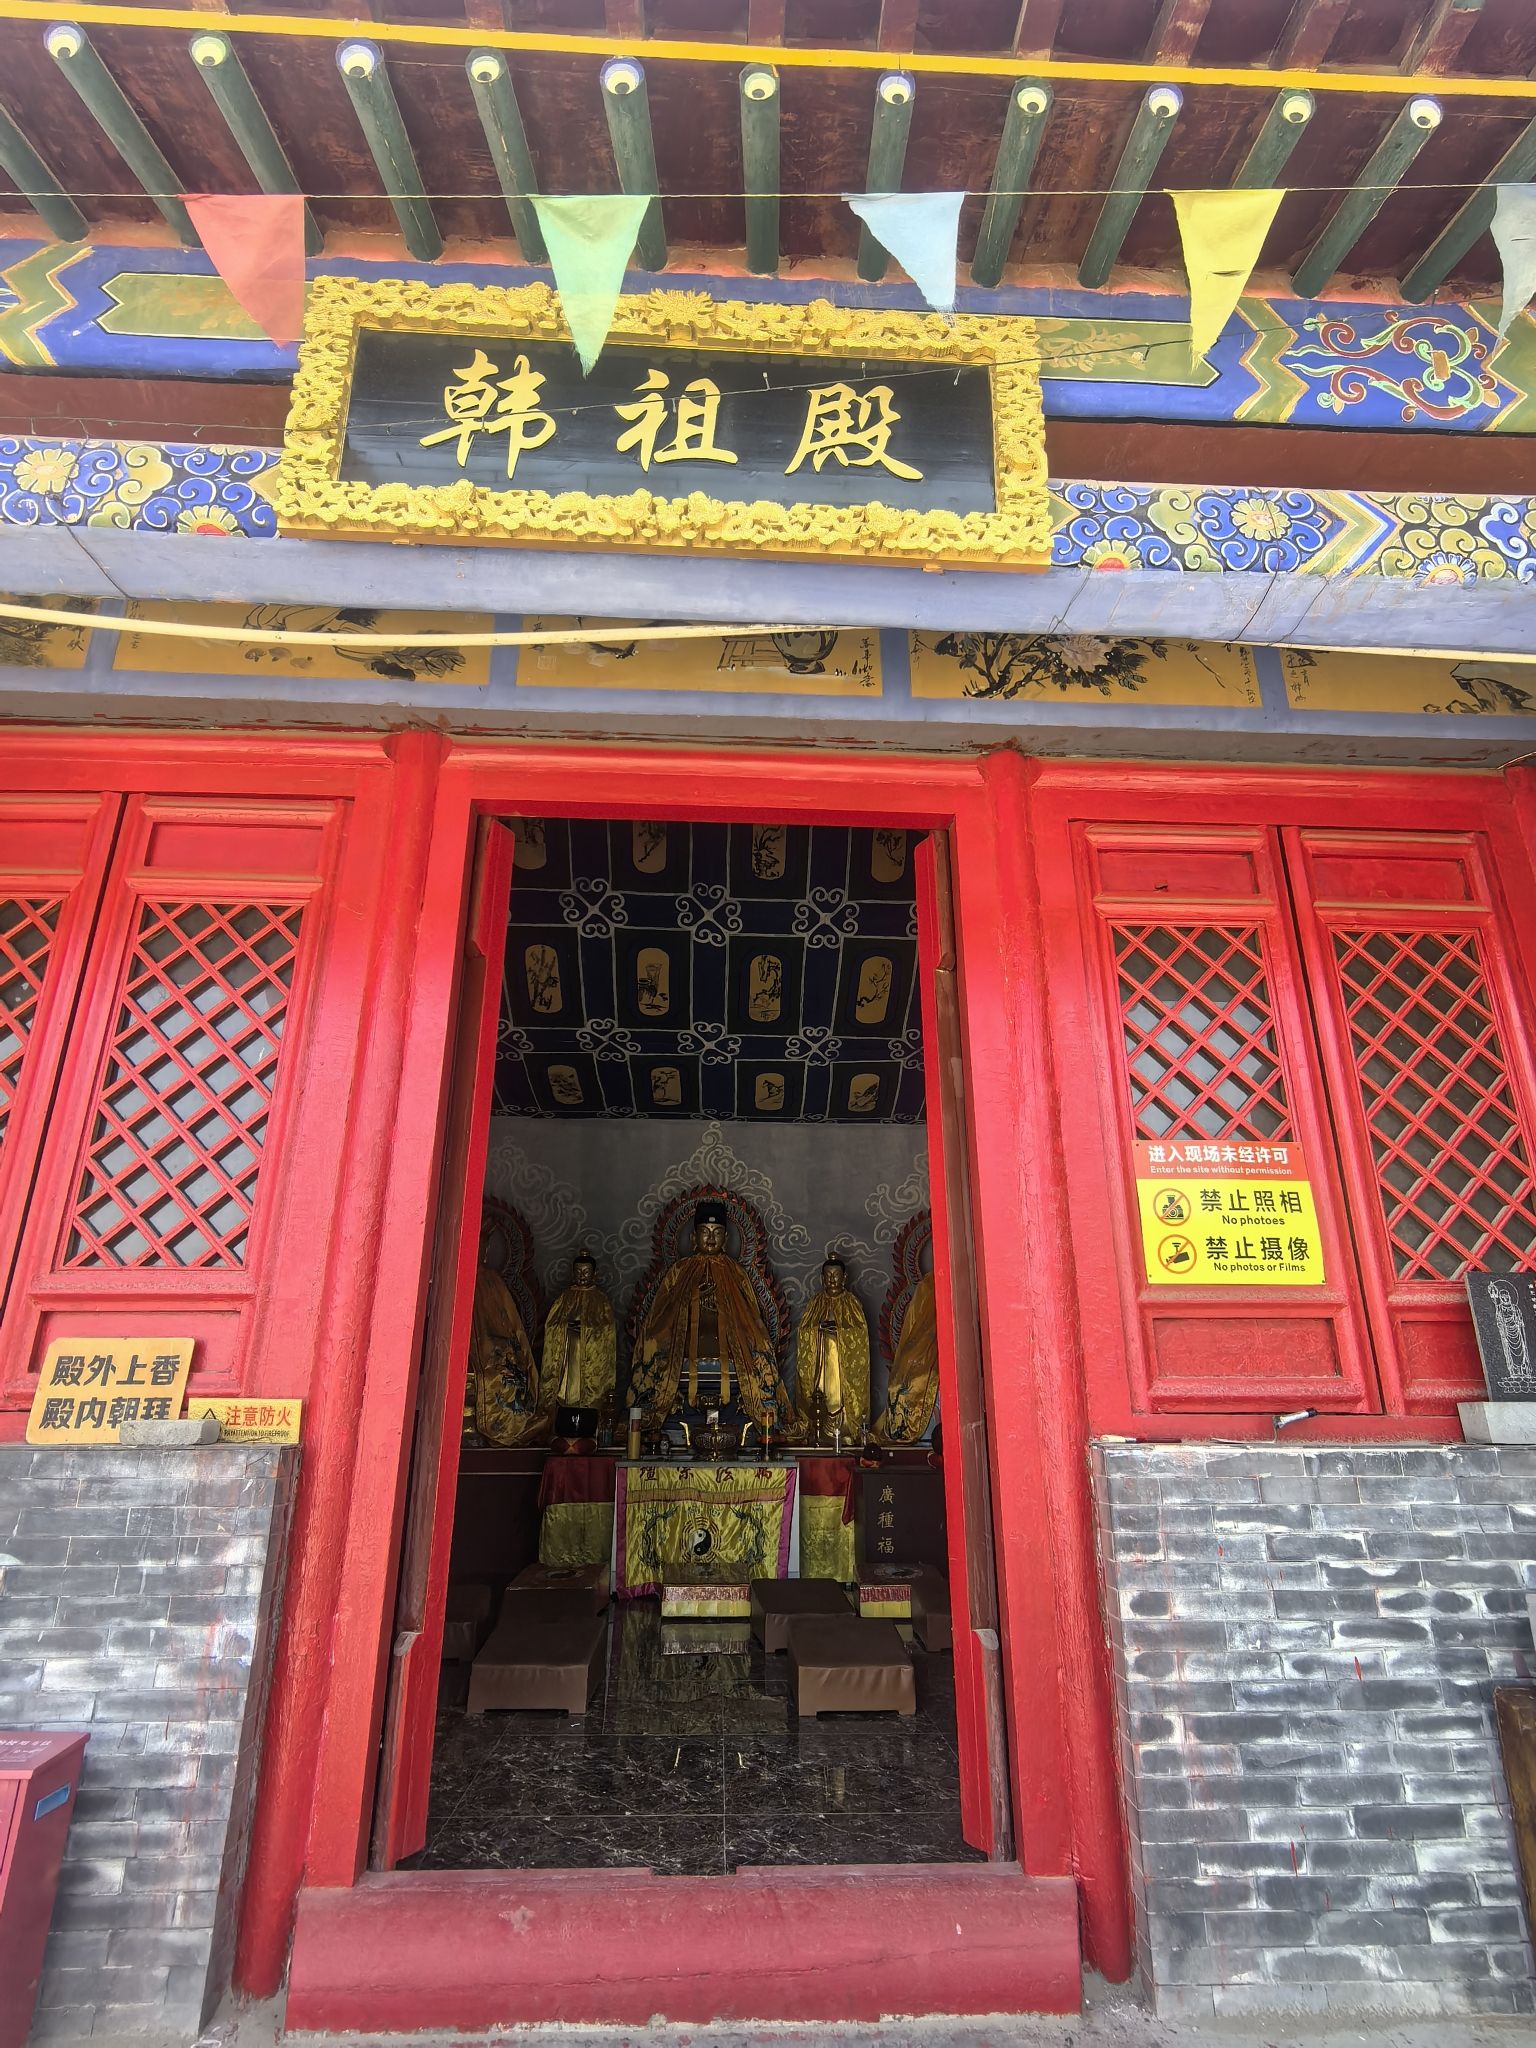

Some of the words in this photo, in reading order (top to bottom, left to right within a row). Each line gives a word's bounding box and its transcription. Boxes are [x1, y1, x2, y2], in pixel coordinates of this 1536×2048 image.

[419, 348, 925, 480] 韩祖殿
[1148, 1145, 1288, 1165] 进入现场未经许可
[1150, 1166, 1175, 1174] Enter
[1176, 1166, 1192, 1174] the
[1193, 1166, 1210, 1175] site
[1211, 1166, 1244, 1175] without
[1245, 1166, 1292, 1176] permission
[1200, 1188, 1303, 1214] 禁止照相
[1221, 1214, 1238, 1225] No
[1240, 1214, 1286, 1227] photoes
[1205, 1235, 1310, 1261] 禁止摄像
[1213, 1262, 1228, 1271] No
[1230, 1262, 1265, 1272] photos
[1266, 1263, 1277, 1272] or
[1279, 1262, 1306, 1272] Films
[50, 1354, 181, 1387] 殿外上香
[224, 1405, 292, 1427] 注意防火
[877, 1484, 895, 1554] 廣種福
